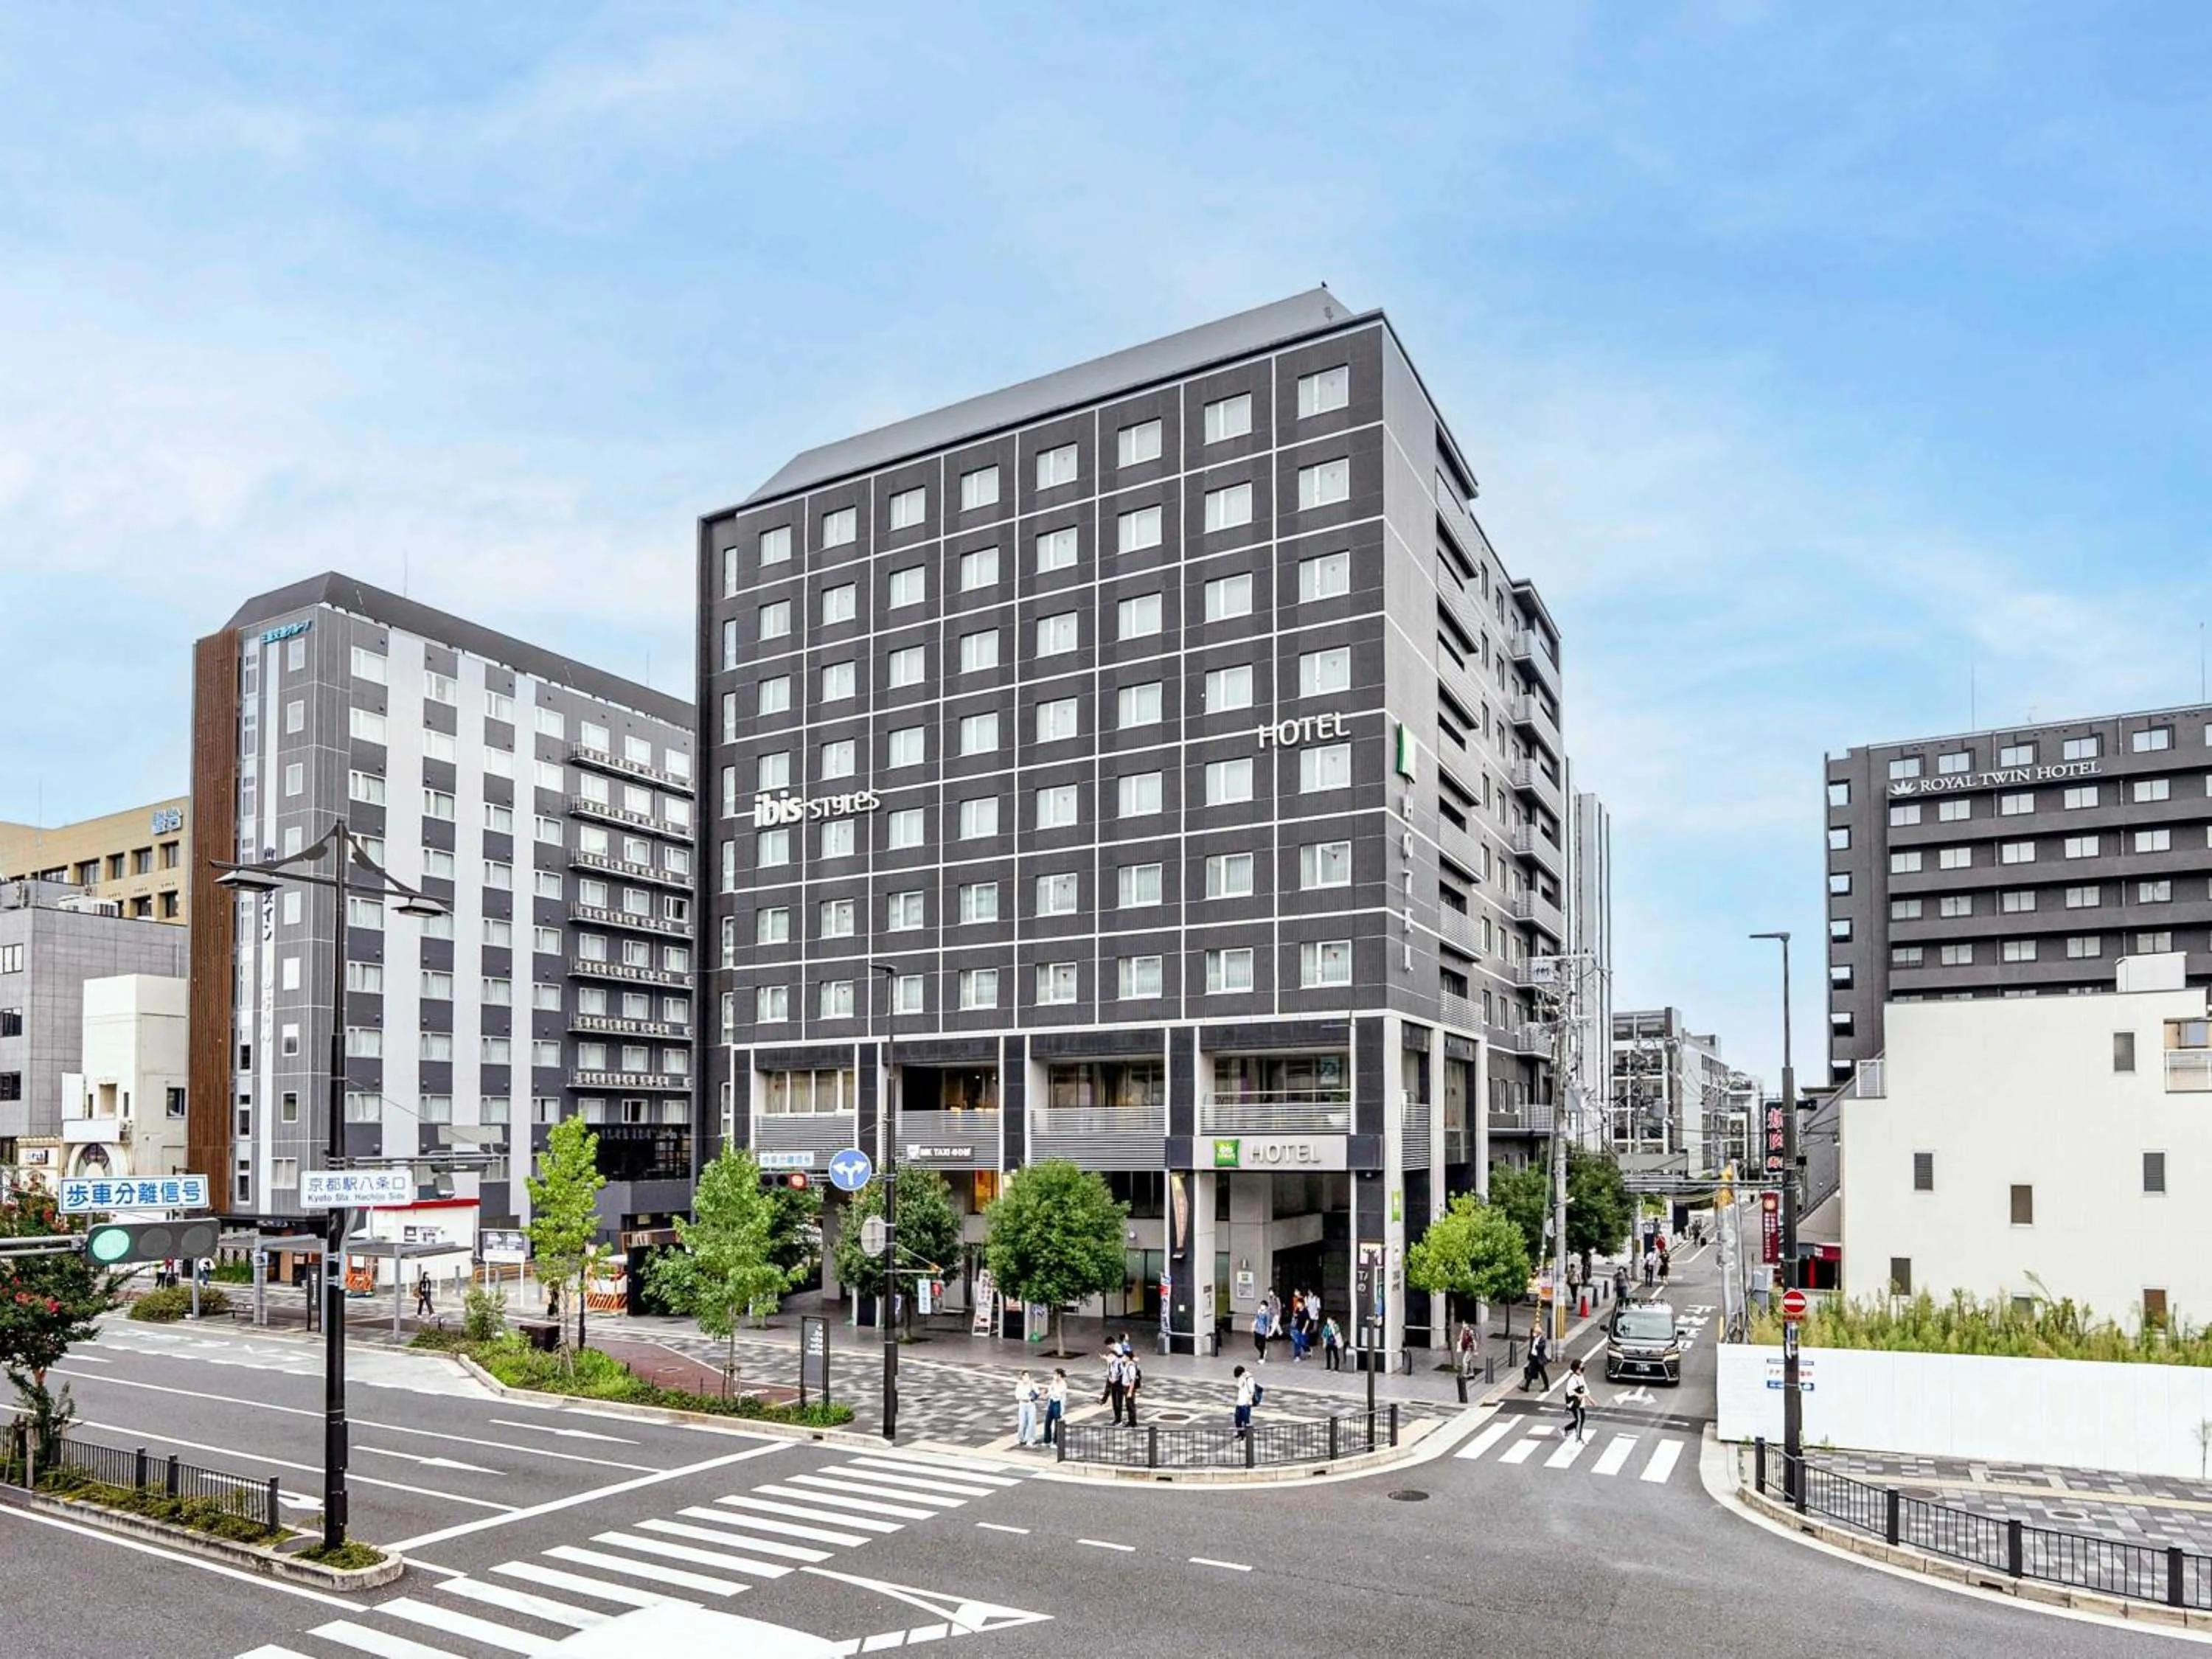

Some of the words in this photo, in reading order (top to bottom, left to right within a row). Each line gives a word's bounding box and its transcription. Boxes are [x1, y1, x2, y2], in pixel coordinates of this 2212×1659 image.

[1259, 712, 1351, 748] HOTEL
[1920, 776, 1977, 793] ROYAL
[1978, 768, 2031, 785] TWIN
[2037, 762, 2101, 779] HOTEL
[754, 790, 803, 828] ibis
[933, 1148, 950, 1156] TAXI
[1250, 1143, 1321, 1163] HOTEL
[66, 1180, 201, 1207] 歩車分離信号
[308, 1176, 406, 1192] 京都駅八条口
[308, 1194, 332, 1203] Kyoto
[389, 1192, 405, 1200] Side
